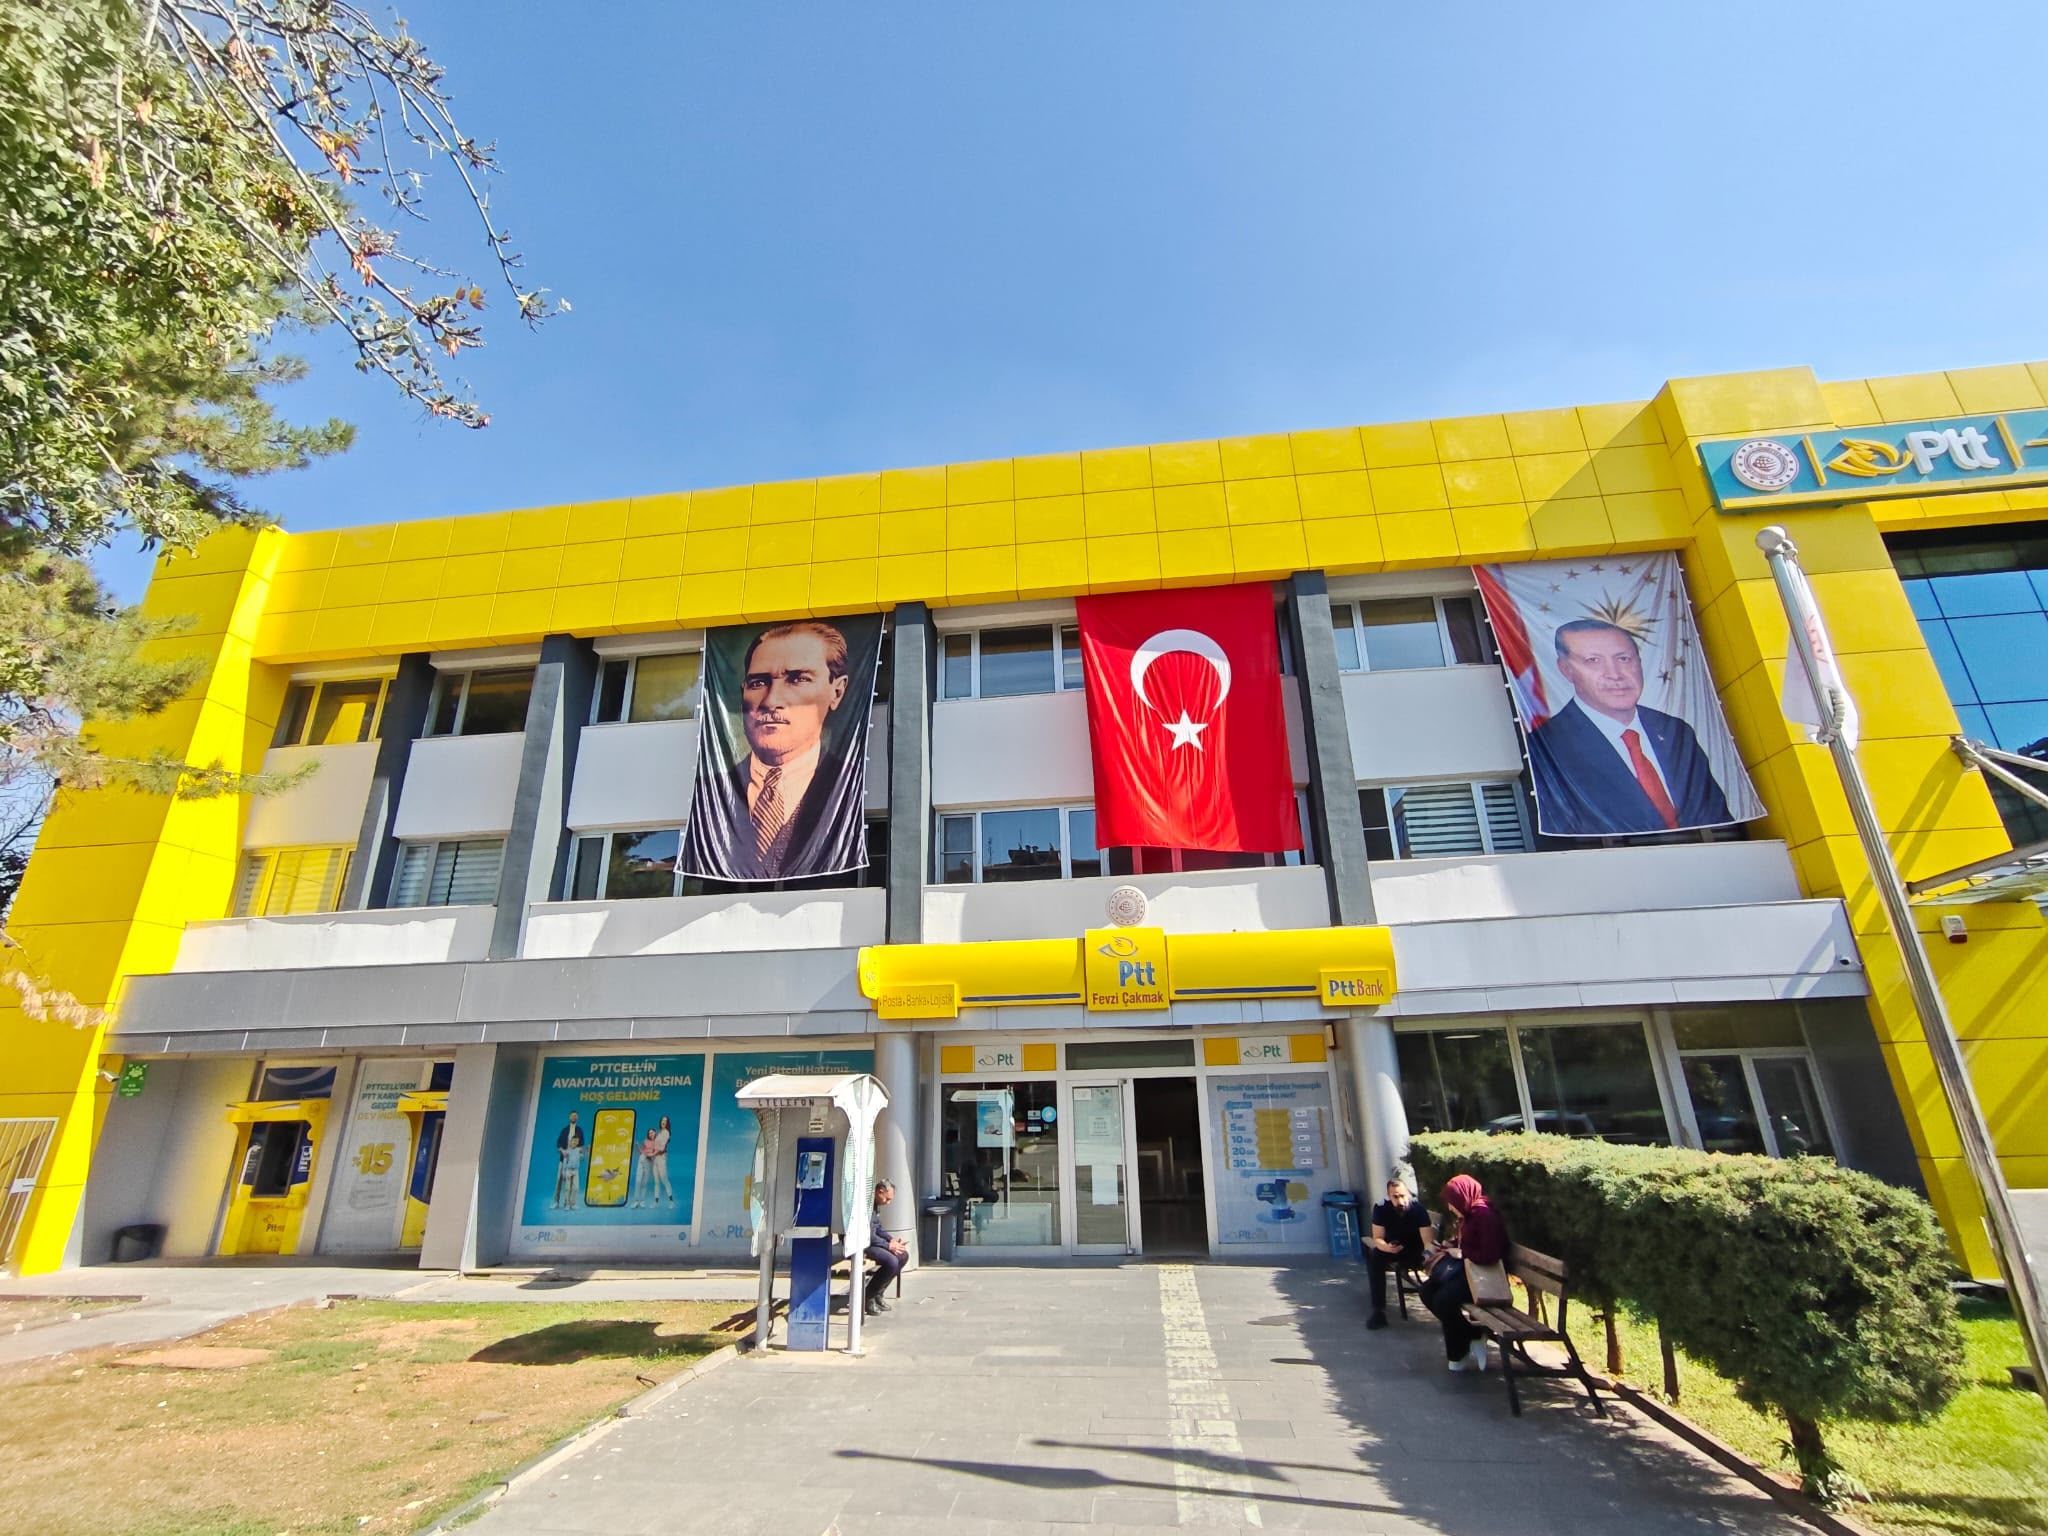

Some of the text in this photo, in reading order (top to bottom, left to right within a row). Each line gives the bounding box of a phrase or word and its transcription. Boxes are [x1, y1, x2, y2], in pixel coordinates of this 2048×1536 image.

[1905, 426, 2000, 475] Ptt
[1119, 960, 1156, 987] Ptt
[1092, 991, 1165, 1007] Fevzi Çakmak
[1263, 1045, 1281, 1057] Ptt
[997, 1053, 1015, 1066] Ptt
[552, 1074, 692, 1088] AVANTAJLI DÜNYASINA
[580, 1088, 661, 1104] HOŞ GELDİNİZ
